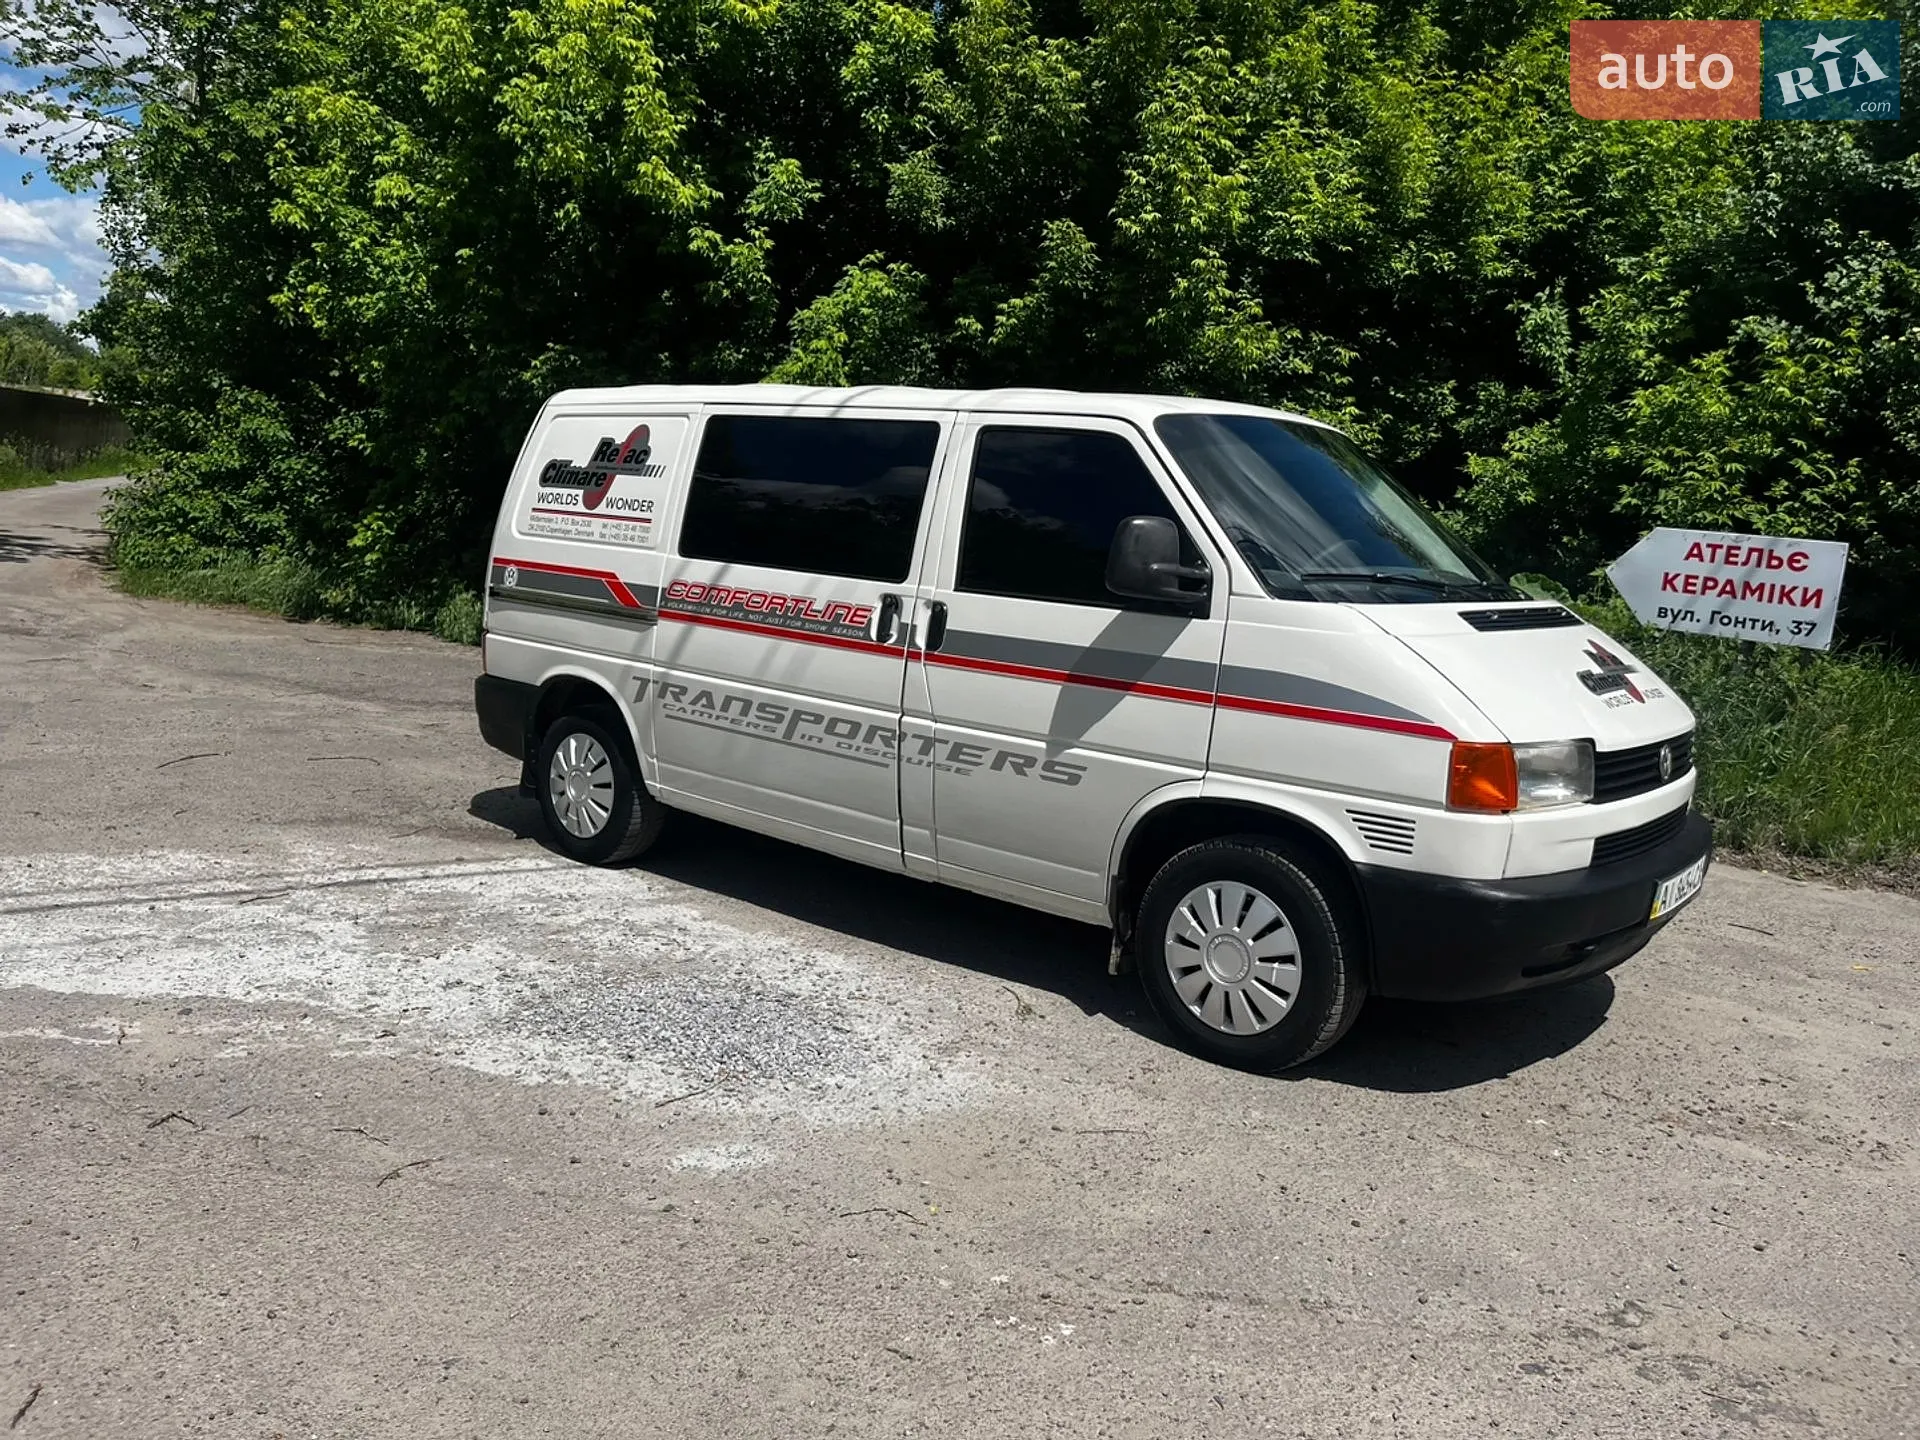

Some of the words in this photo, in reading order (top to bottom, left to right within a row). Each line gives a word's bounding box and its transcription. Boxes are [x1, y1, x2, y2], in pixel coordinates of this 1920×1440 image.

[541, 461, 607, 487] Climare
[537, 491, 579, 506] WORLDS
[605, 497, 654, 513] WONDER
[1683, 541, 1810, 572] АТЕЛЬЄ
[666, 579, 875, 626] COMFORTLINE
[1661, 571, 1824, 609] КЕРАМІКИ
[712, 607, 727, 617] FOR
[748, 613, 763, 622] NOT
[766, 615, 785, 625] JUST
[786, 618, 802, 628] FOR
[805, 621, 827, 632] SHOW
[1657, 606, 1701, 624] вул.
[1709, 610, 1781, 635] Гонти,
[1789, 619, 1818, 637] 37
[631, 675, 1088, 787] TRANSPORTERS
[662, 702, 777, 734] CAMPERS
[835, 740, 974, 776] DISGUISE
